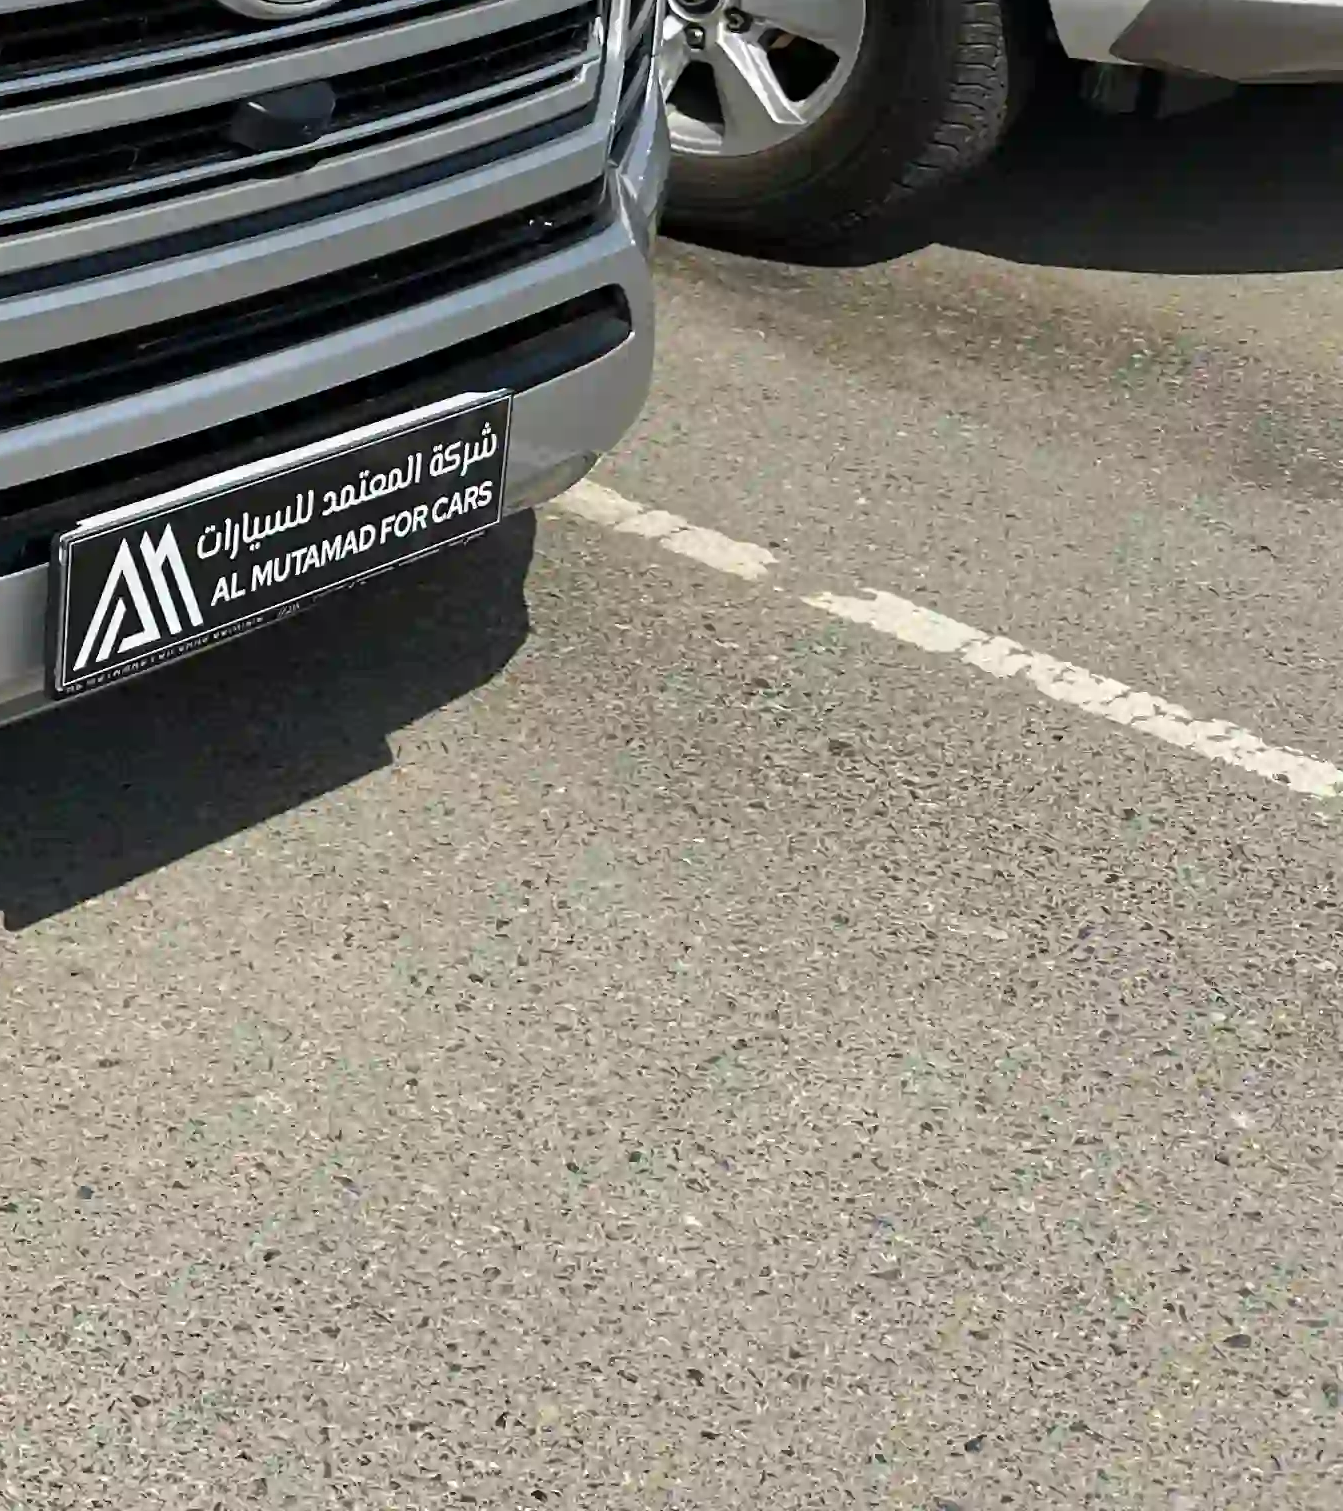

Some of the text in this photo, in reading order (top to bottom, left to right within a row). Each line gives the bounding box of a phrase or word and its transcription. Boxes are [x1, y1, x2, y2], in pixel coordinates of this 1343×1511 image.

[196, 421, 498, 561] شركة المعتمد للسيارات
[210, 480, 494, 606] AL MUTAMAD FOR CARS
